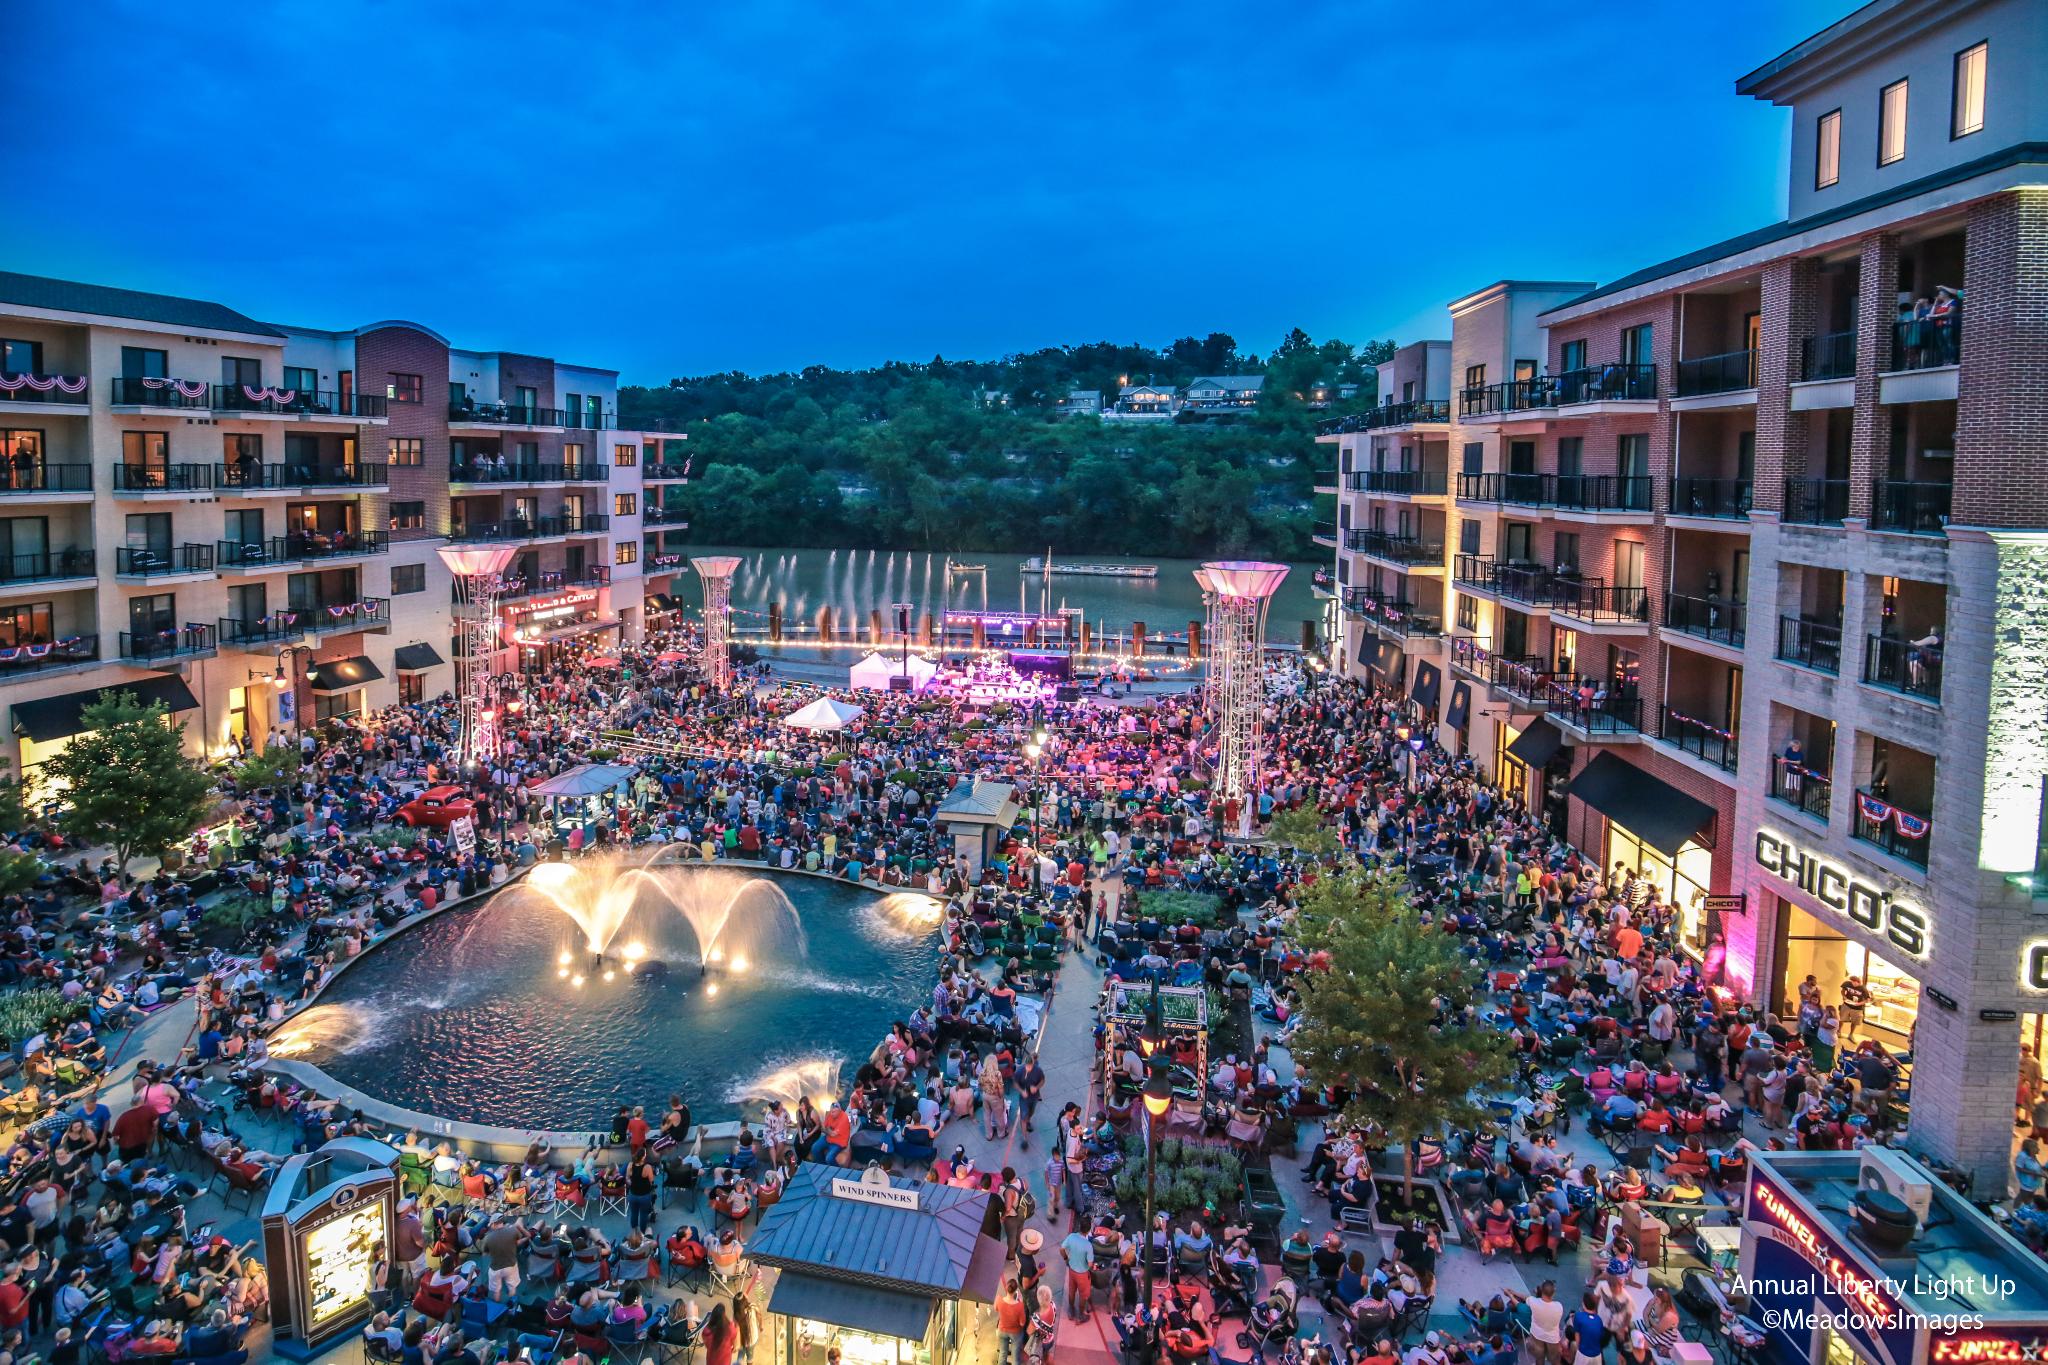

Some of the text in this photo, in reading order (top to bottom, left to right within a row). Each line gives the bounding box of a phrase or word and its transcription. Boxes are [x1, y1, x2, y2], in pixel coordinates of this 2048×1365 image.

[508, 603, 536, 615] TES
[1756, 831, 1926, 955] CHICO'S
[1706, 901, 1741, 909] CHICO'S
[839, 1185, 912, 1203] WIND SPINNERS
[313, 1193, 377, 1227] DIRECTORY
[1757, 1184, 1816, 1253] FUNNEL
[1772, 1228, 1796, 1249] AND
